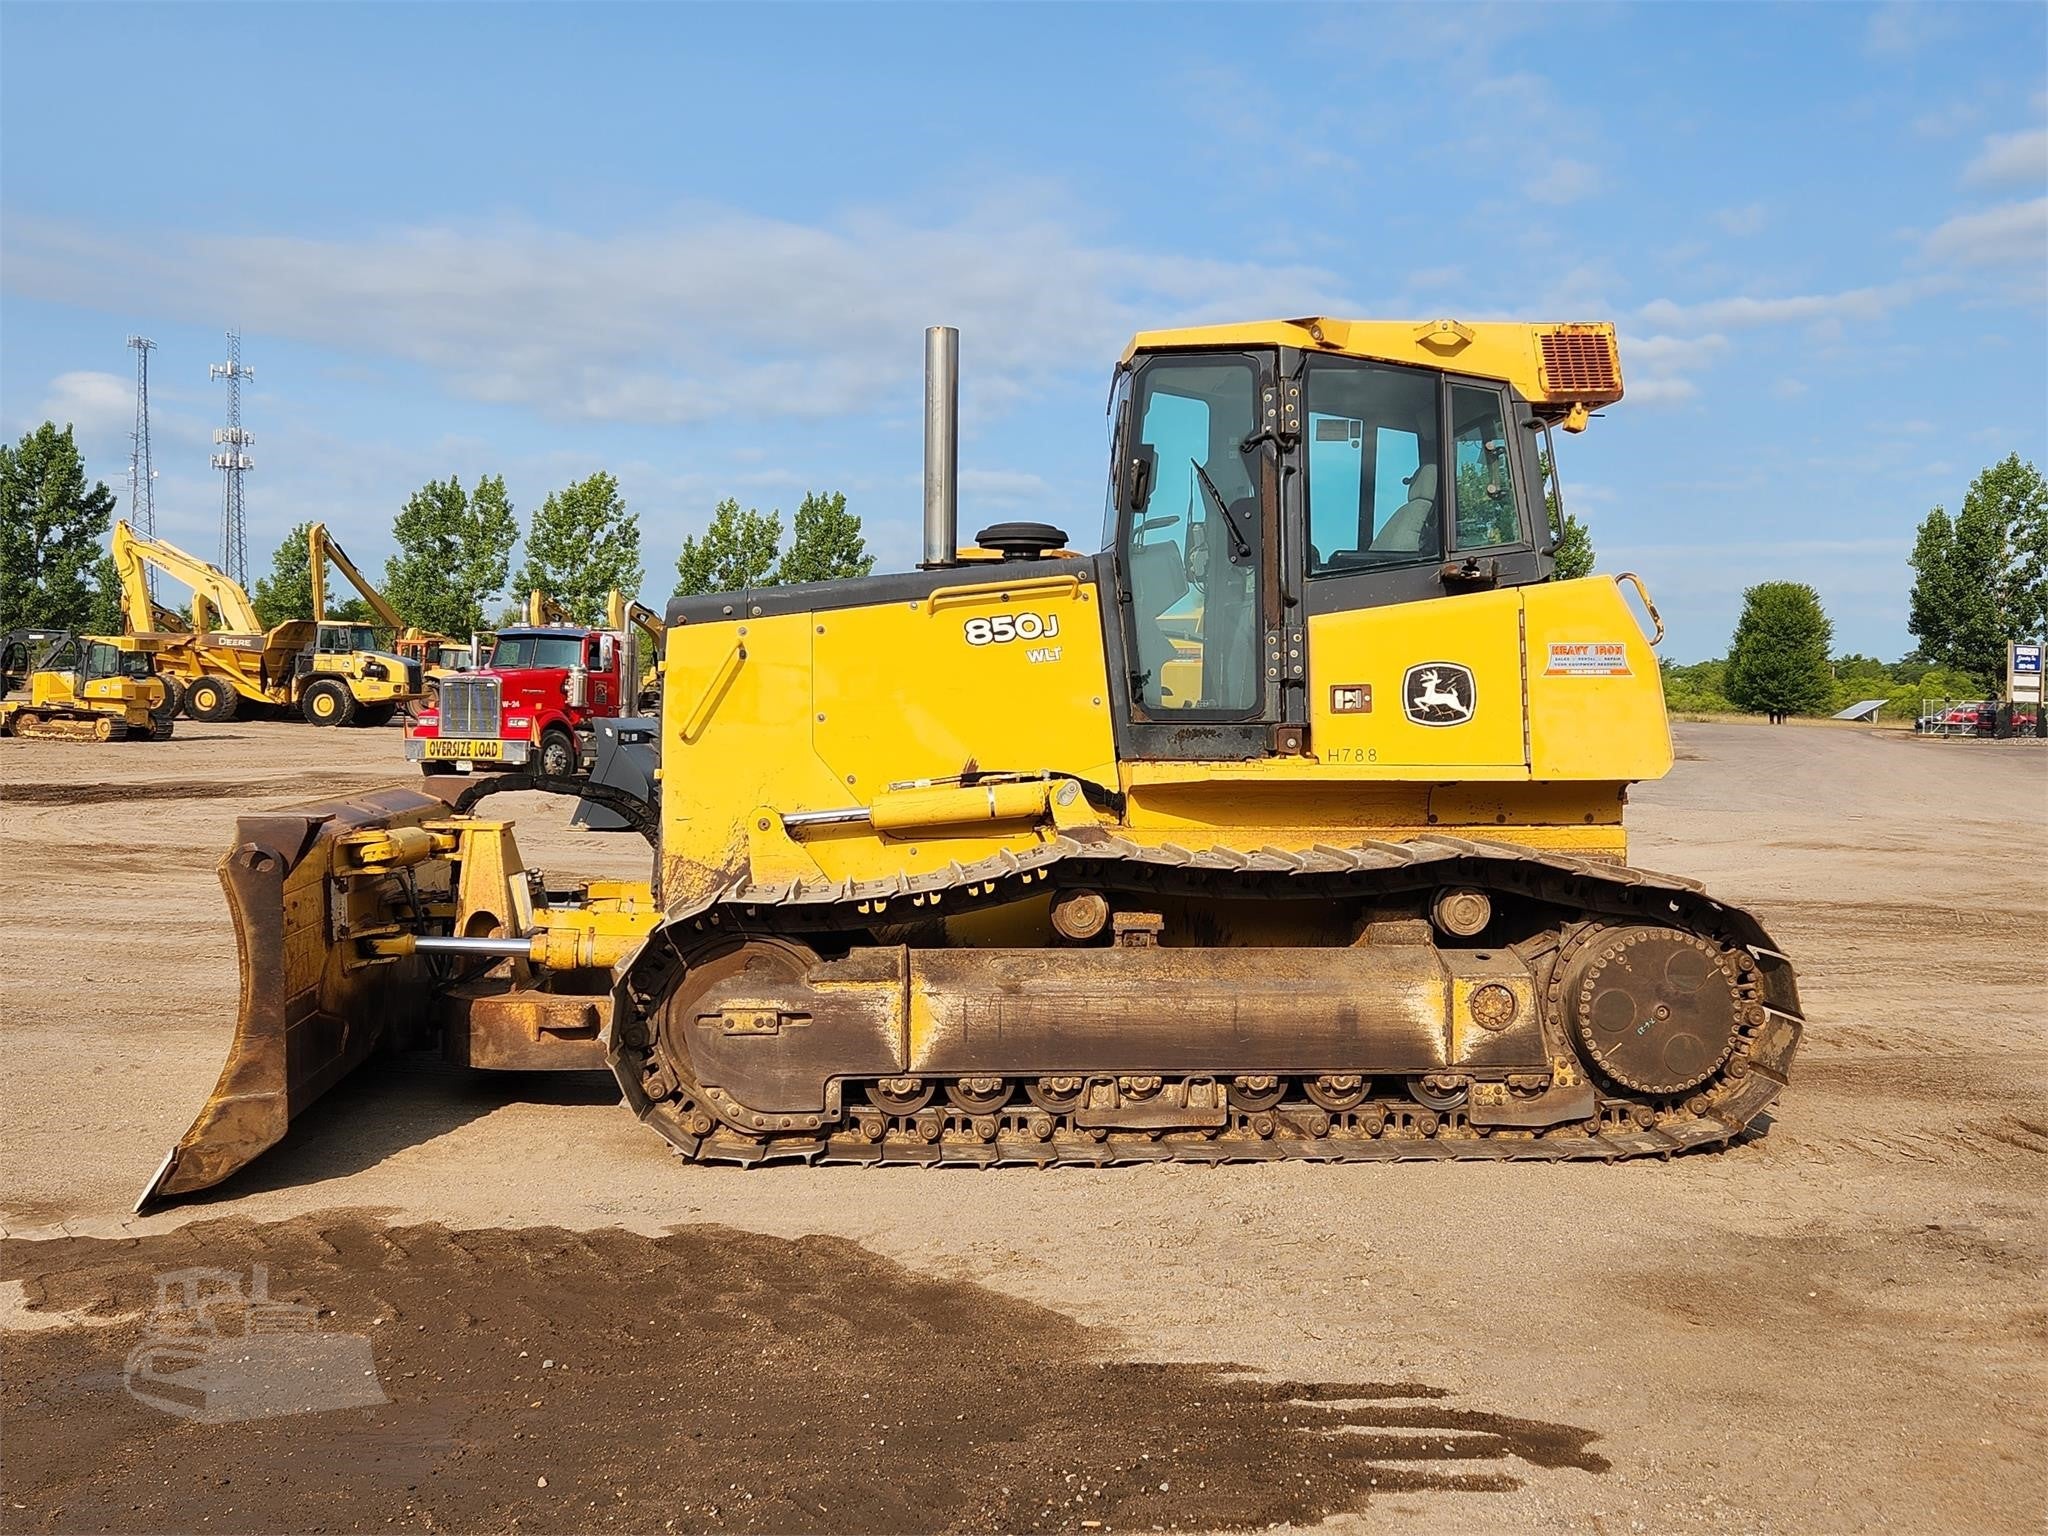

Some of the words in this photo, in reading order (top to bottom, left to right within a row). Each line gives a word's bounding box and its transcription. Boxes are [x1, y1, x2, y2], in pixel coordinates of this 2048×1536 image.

[964, 612, 1059, 645] 850J
[218, 637, 252, 647] DEERE
[1026, 646, 1062, 663] WLT
[1551, 645, 1589, 655] HEAVY
[1594, 645, 1623, 655] IRON
[502, 700, 520, 708] W-24
[429, 741, 472, 757] OVERSIZE
[474, 742, 498, 758] LOAD
[1329, 748, 1377, 762] H788
